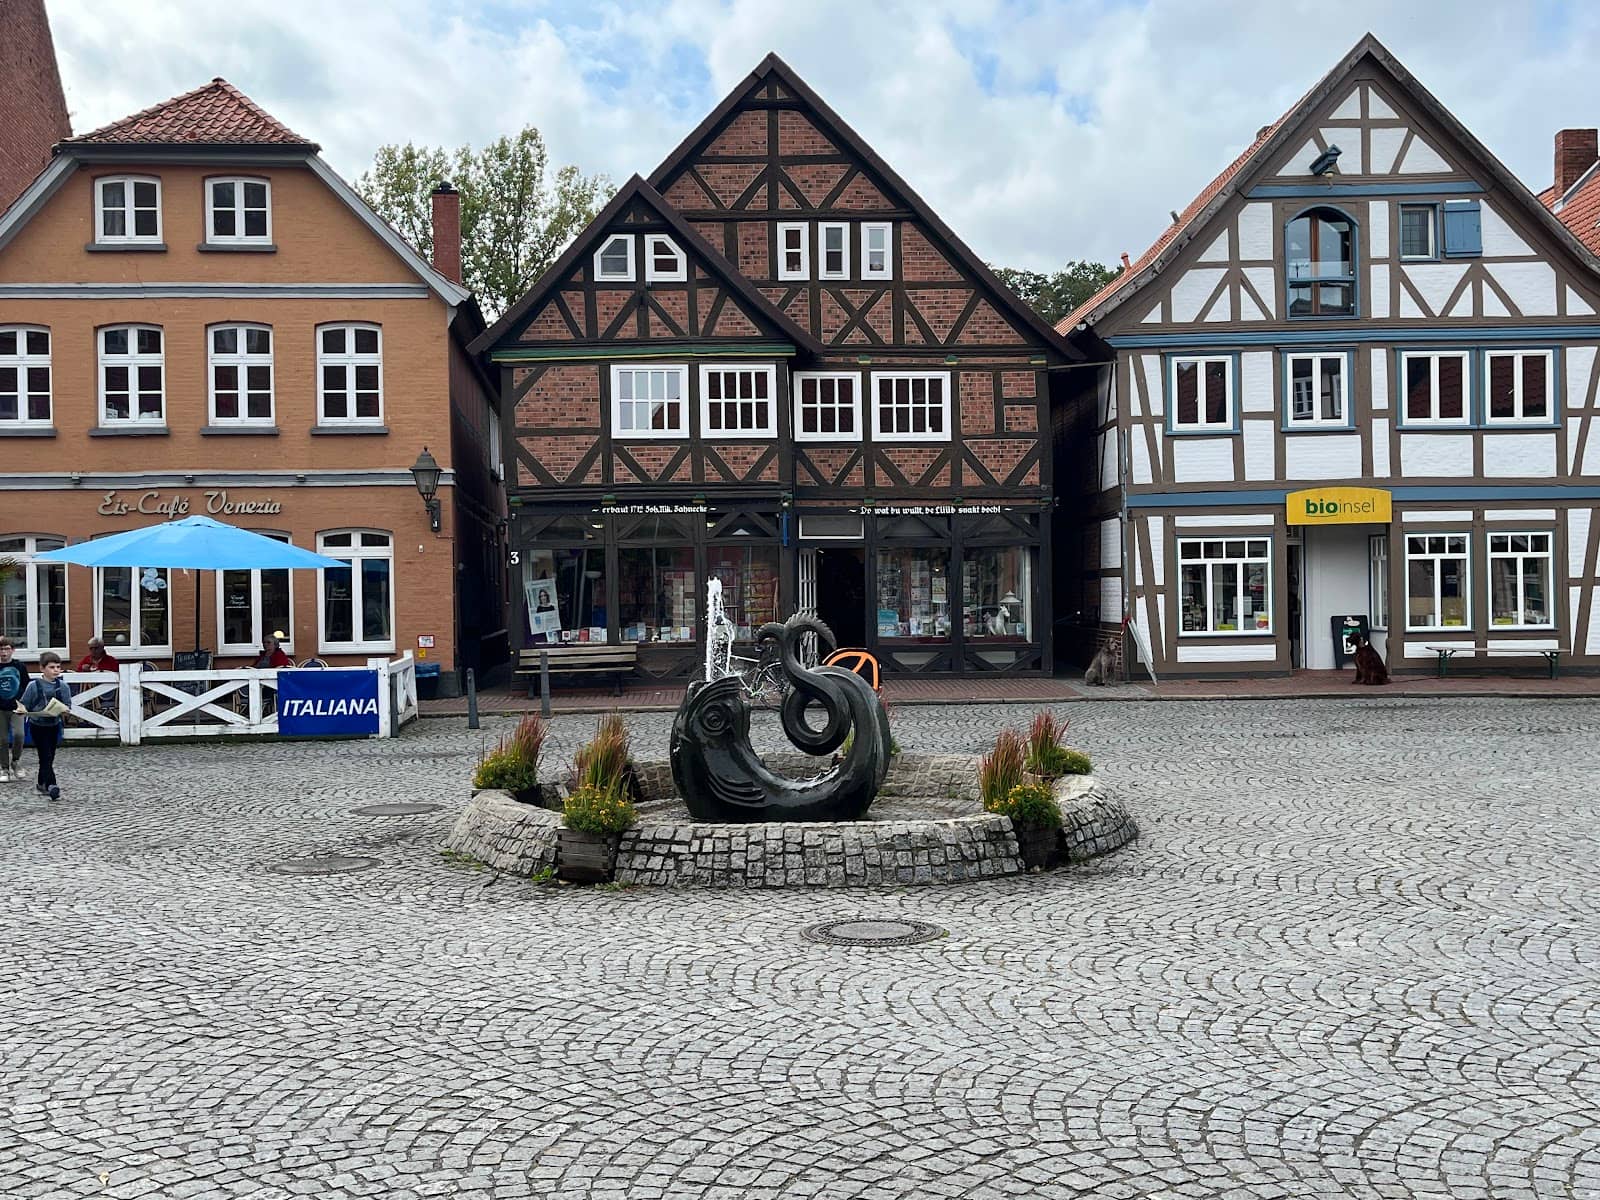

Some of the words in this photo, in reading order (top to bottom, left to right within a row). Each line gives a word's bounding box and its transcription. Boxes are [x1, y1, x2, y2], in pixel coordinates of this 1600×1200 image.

[97, 491, 190, 519] Eis-Café
[203, 490, 282, 515] Venezia
[602, 505, 628, 514] erbaut
[874, 506, 889, 514] wat
[957, 506, 980, 514] snakt
[1305, 497, 1375, 514] bioinsel
[510, 551, 520, 565] 3
[283, 698, 378, 717] ITALIANA
